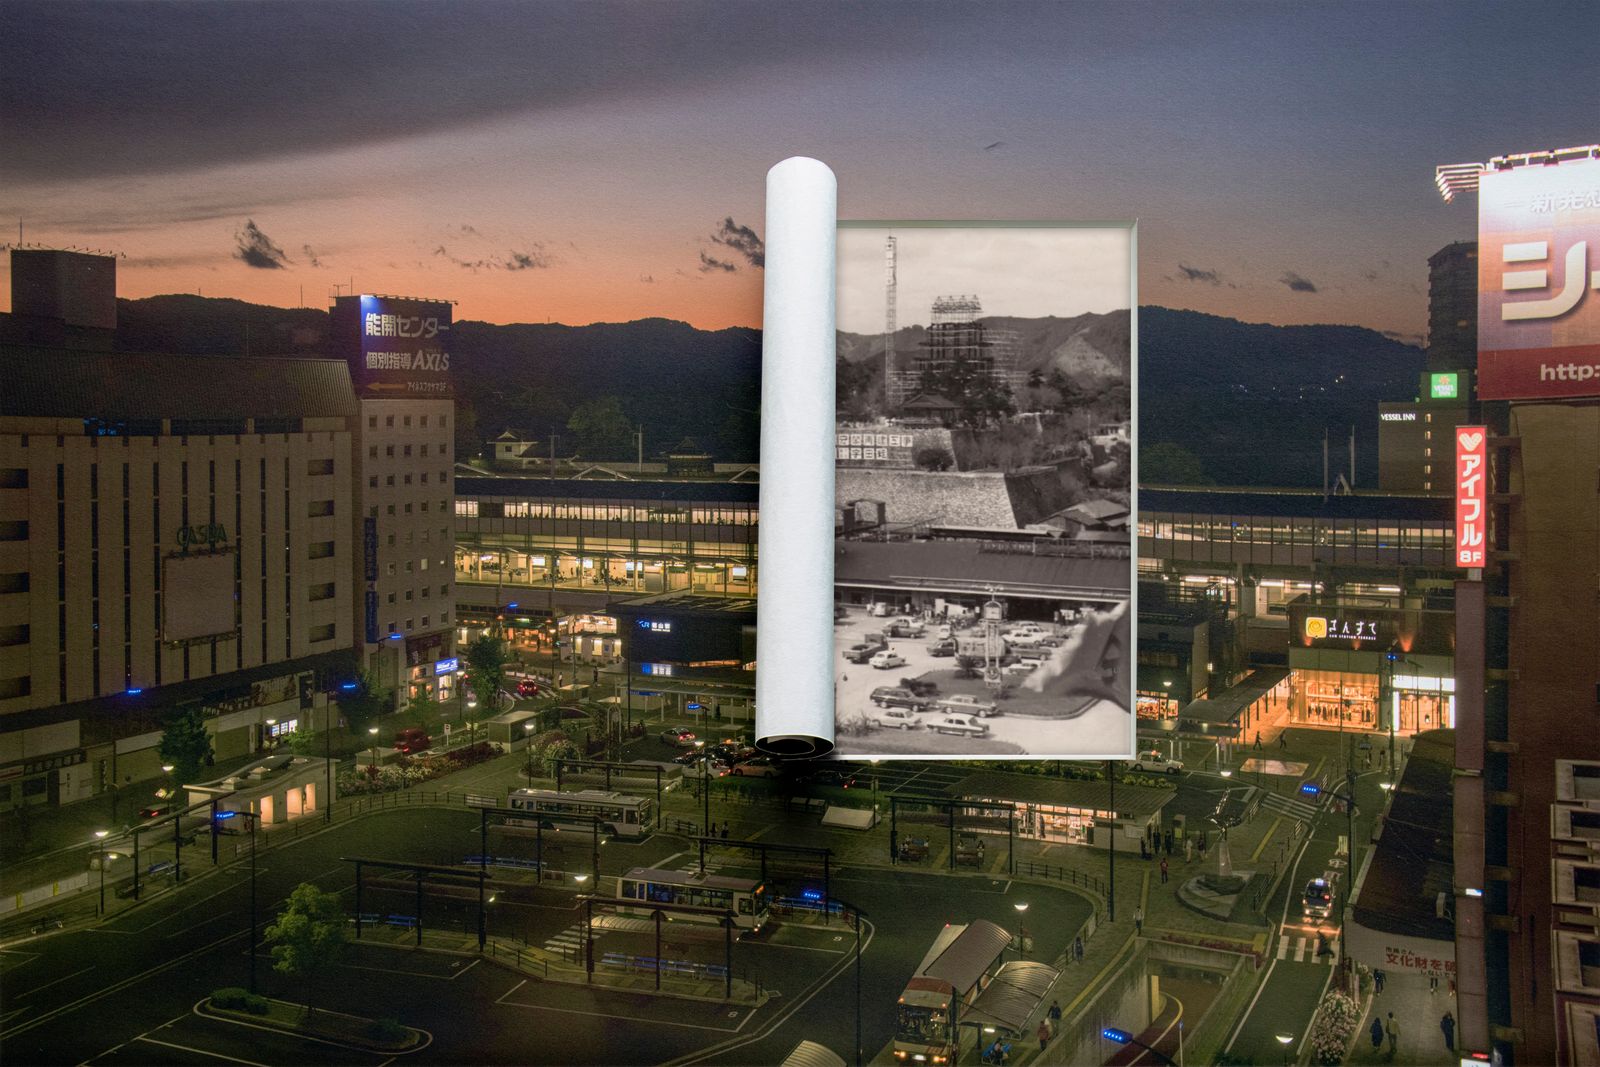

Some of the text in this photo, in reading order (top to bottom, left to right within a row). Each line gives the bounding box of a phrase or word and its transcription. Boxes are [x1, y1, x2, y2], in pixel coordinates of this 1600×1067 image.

[365, 313, 450, 338] 能開センター
[366, 351, 411, 370] 個別指導
[1381, 413, 1416, 421] VESSEL INN
[1461, 454, 1482, 547] アイフル
[1460, 550, 1482, 562] 8F
[1328, 619, 1377, 636] さんすて
